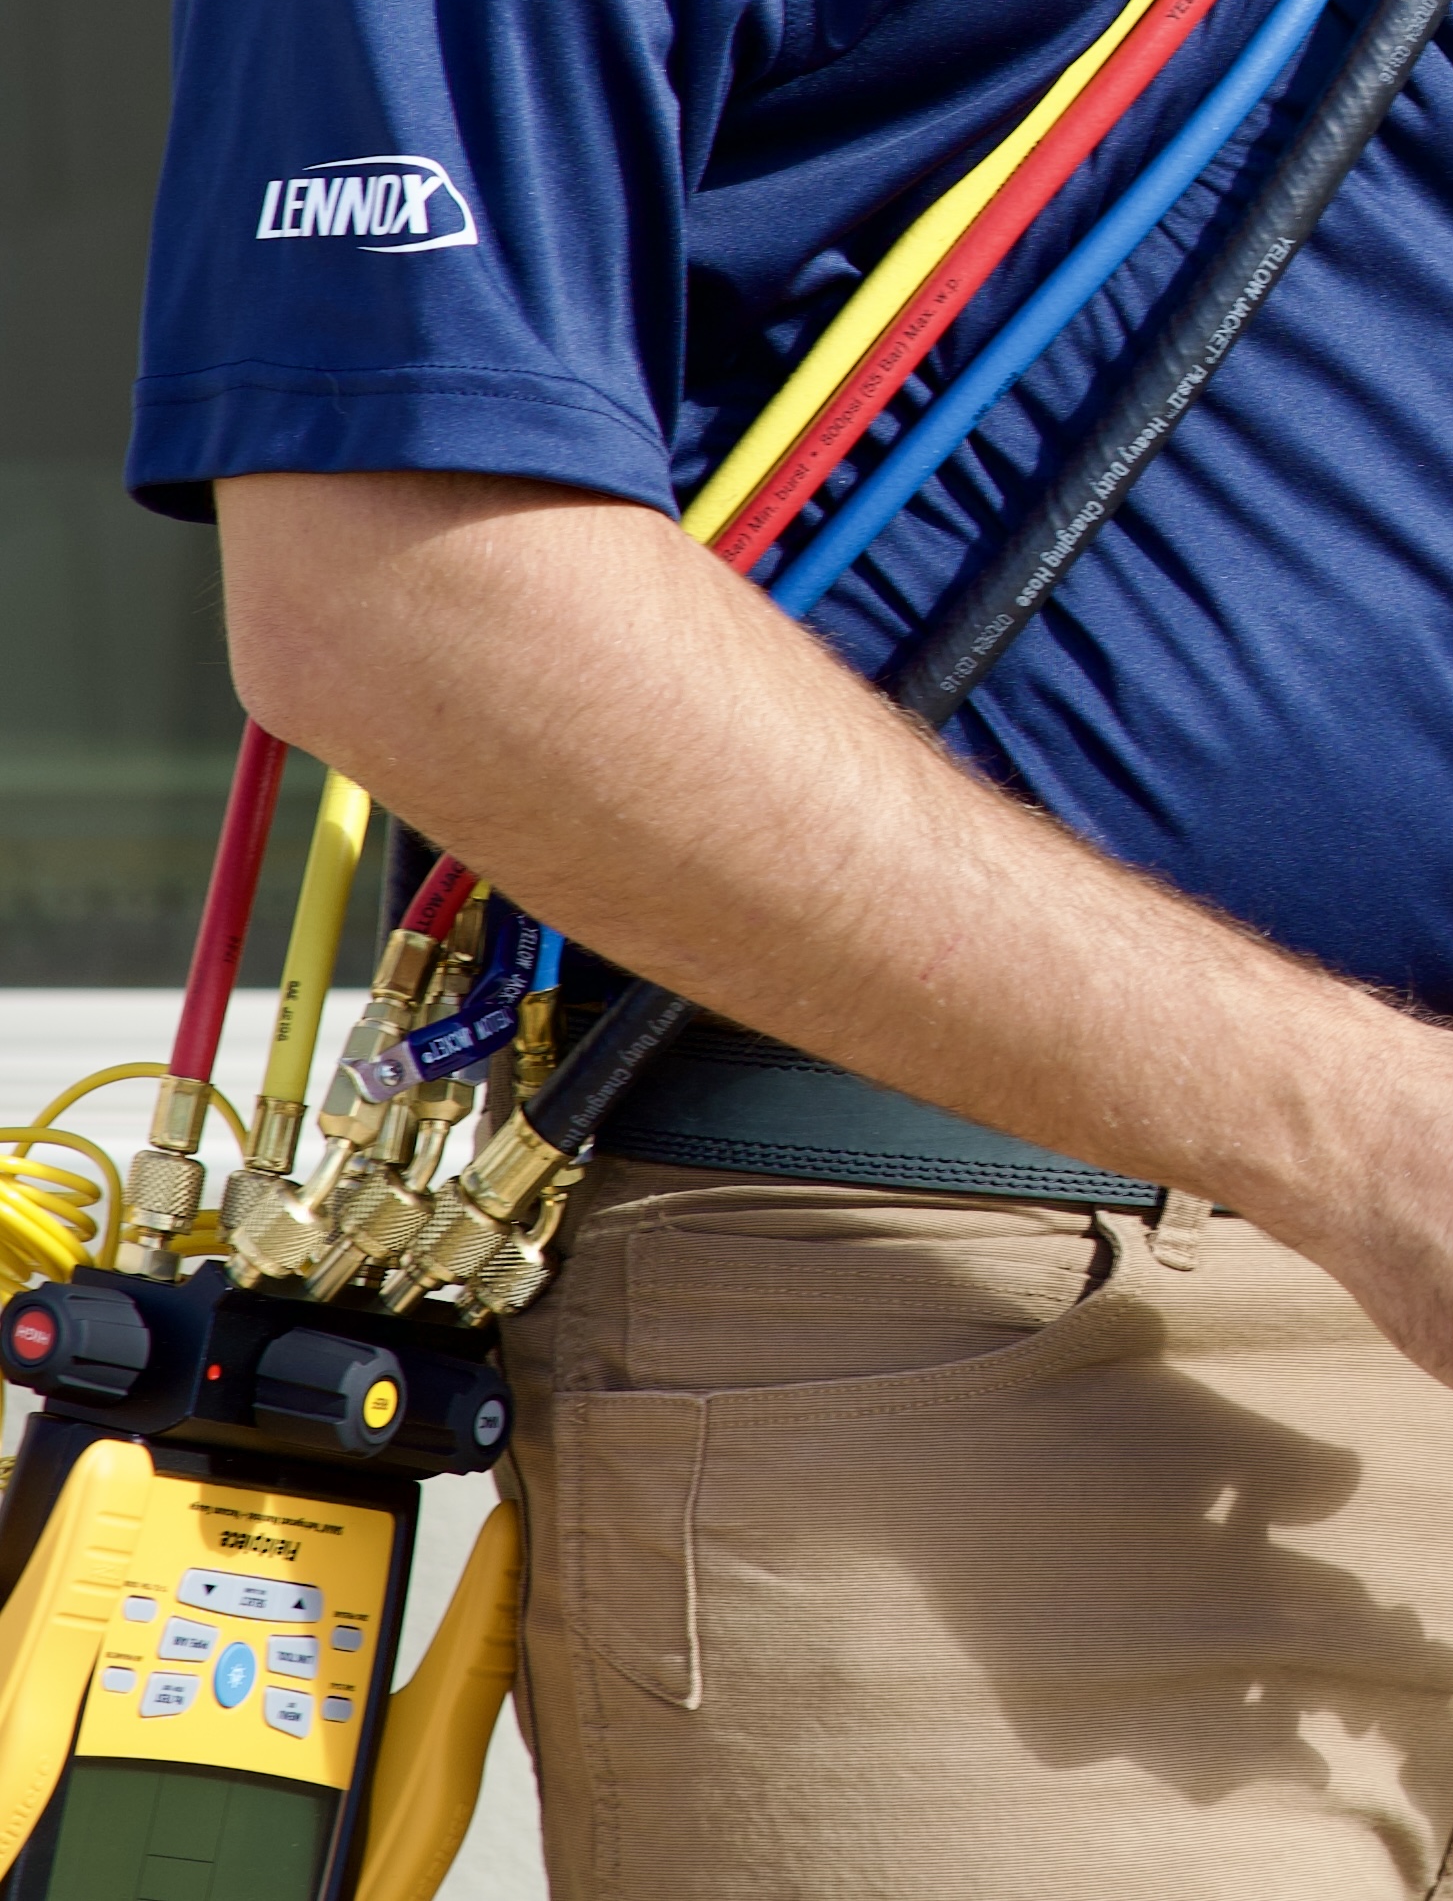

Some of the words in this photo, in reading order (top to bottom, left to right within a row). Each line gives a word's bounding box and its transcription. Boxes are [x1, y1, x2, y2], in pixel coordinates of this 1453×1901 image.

[256, 174, 446, 240] LENNOX
[1243, 235, 1296, 298] YELLOW
[747, 501, 776, 532] Min.
[774, 463, 808, 500] burst
[820, 398, 863, 446] 800psi
[879, 340, 908, 371] Bar)
[903, 304, 936, 340] Max.
[933, 273, 963, 305] w.p.
[1117, 411, 1166, 465] Heavy
[1091, 460, 1129, 499] Duty
[1041, 498, 1102, 567] Charging
[1013, 565, 1053, 609] Hose
[510, 925, 544, 968] YELLOW
[617, 1026, 657, 1067] Duty
[570, 1063, 629, 1128] Charging
[15, 1324, 52, 1347] HIGH
[219, 1531, 301, 1562] Fieldpiece
